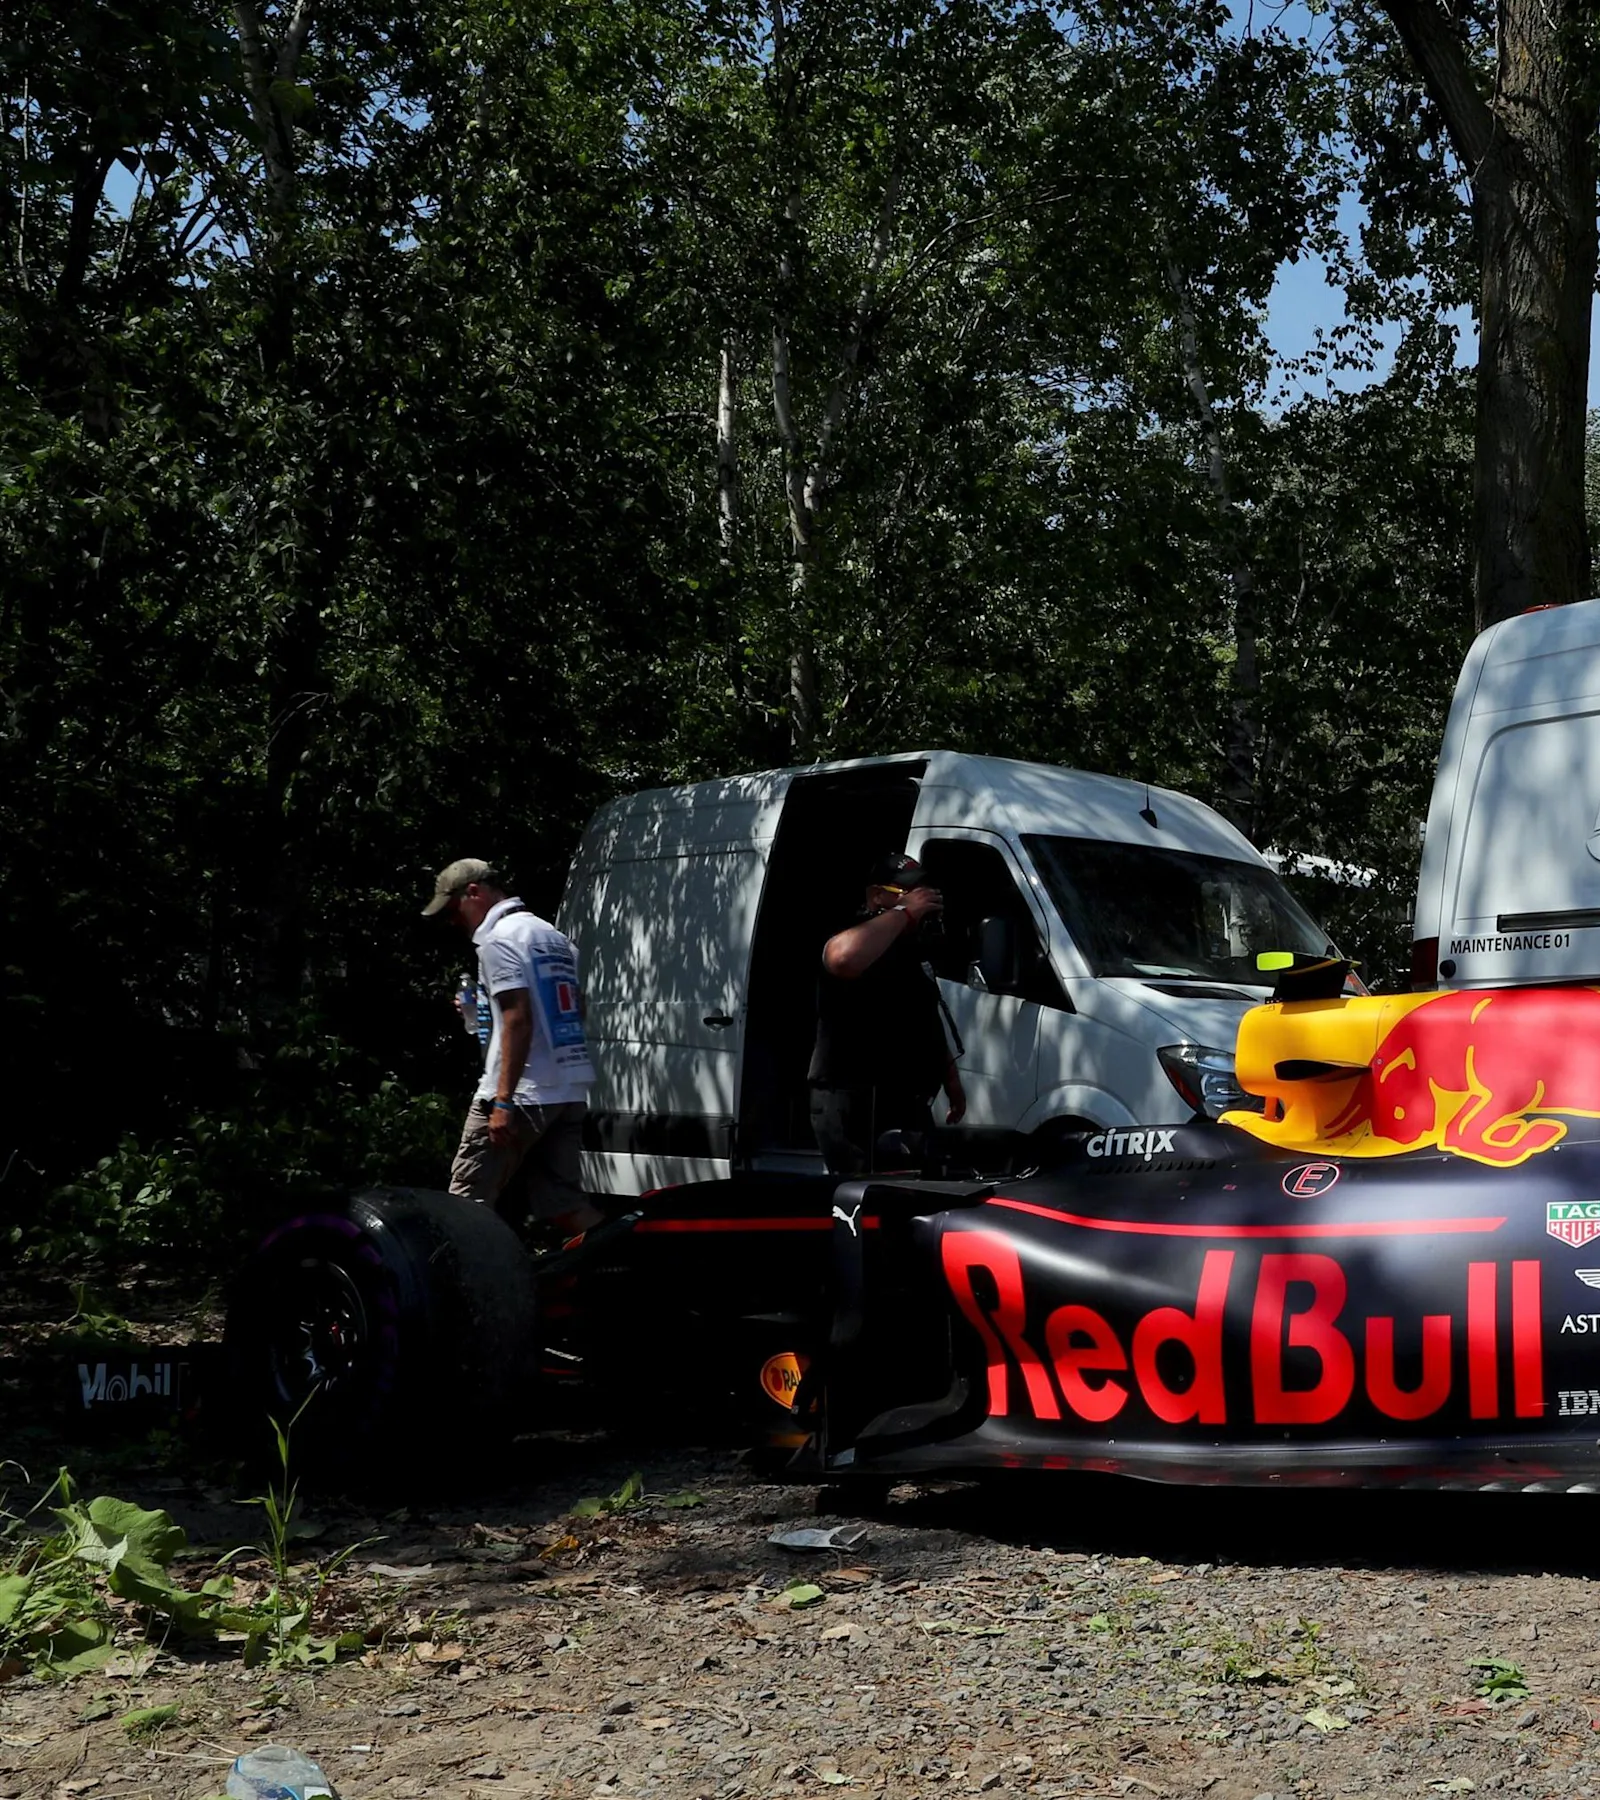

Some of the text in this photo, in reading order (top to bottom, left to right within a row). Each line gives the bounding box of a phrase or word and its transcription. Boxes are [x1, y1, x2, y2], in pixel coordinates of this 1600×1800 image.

[1449, 933, 1571, 955] MAINTENANCE 01
[1291, 1165, 1330, 1194] E
